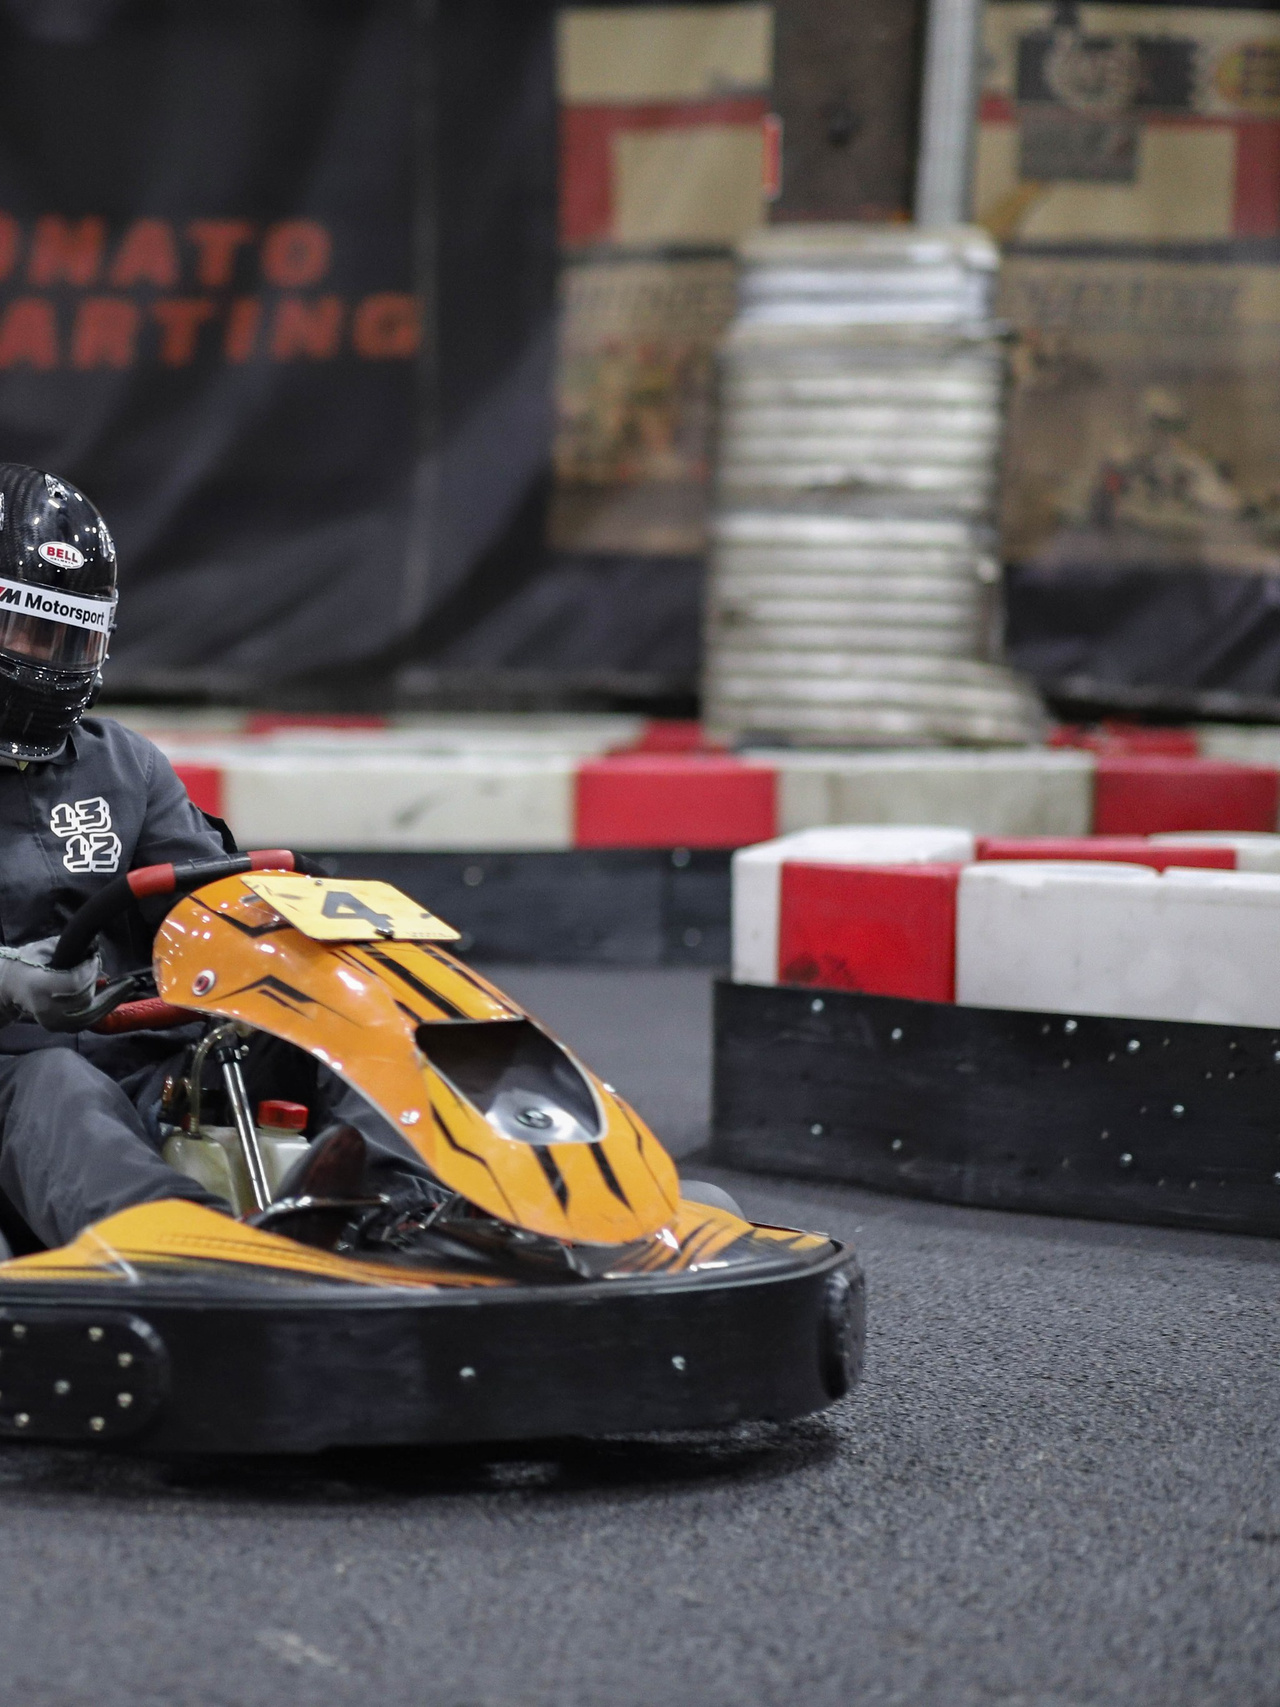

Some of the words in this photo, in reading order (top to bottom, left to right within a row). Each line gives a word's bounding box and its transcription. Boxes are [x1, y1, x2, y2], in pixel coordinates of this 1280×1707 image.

[47, 546, 78, 563] BELL
[24, 592, 105, 626] Motorsport
[50, 796, 112, 838] 13
[63, 832, 122, 873] 12
[321, 890, 395, 929] 4
